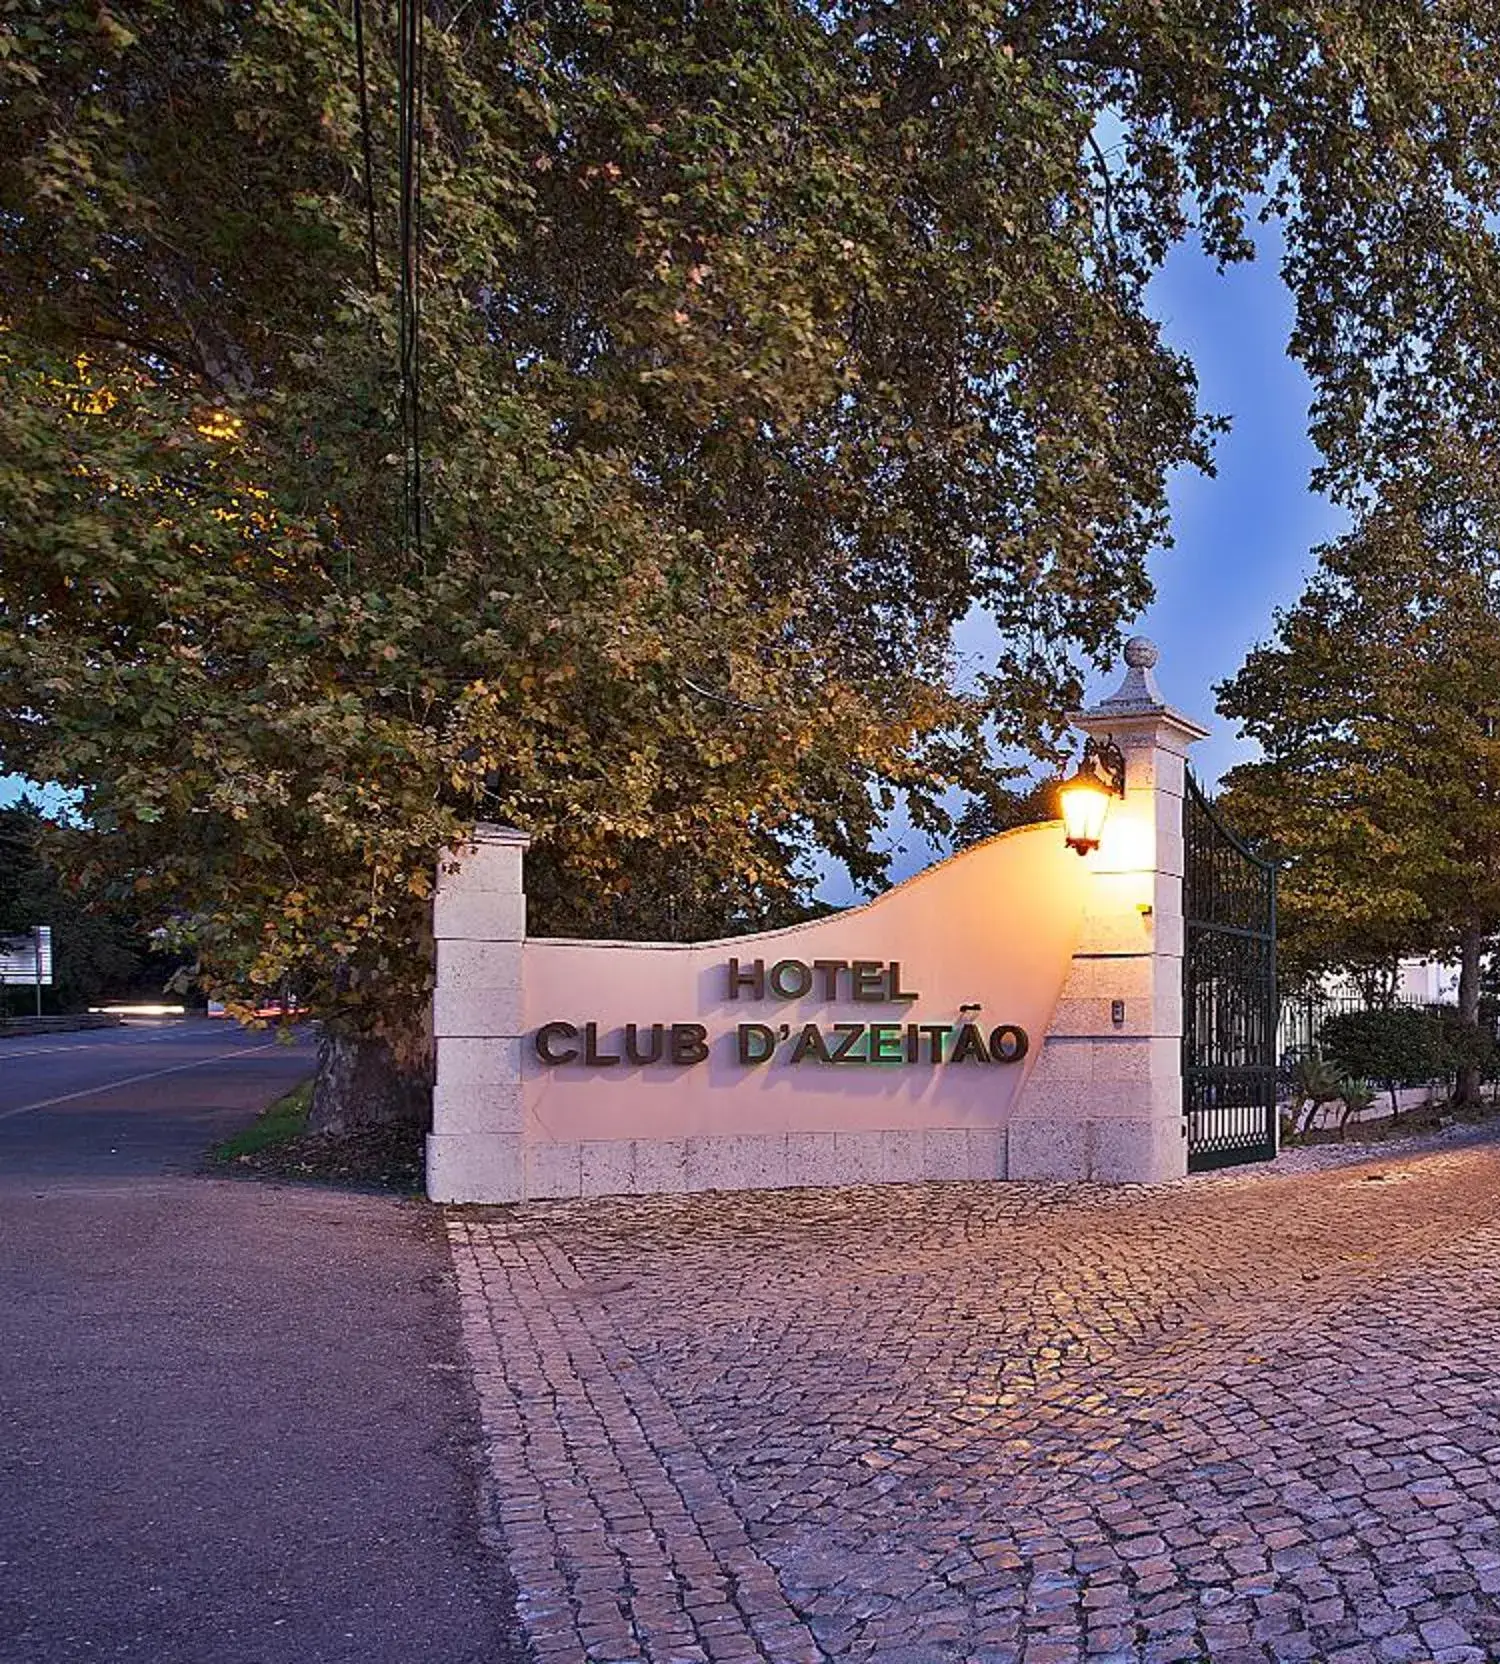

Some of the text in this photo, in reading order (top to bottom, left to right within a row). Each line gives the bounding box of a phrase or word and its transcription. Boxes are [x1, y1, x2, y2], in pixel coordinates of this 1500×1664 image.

[727, 957, 919, 1003] HOTEL
[535, 1003, 1029, 1066] CLUB D'AZEITÃO
